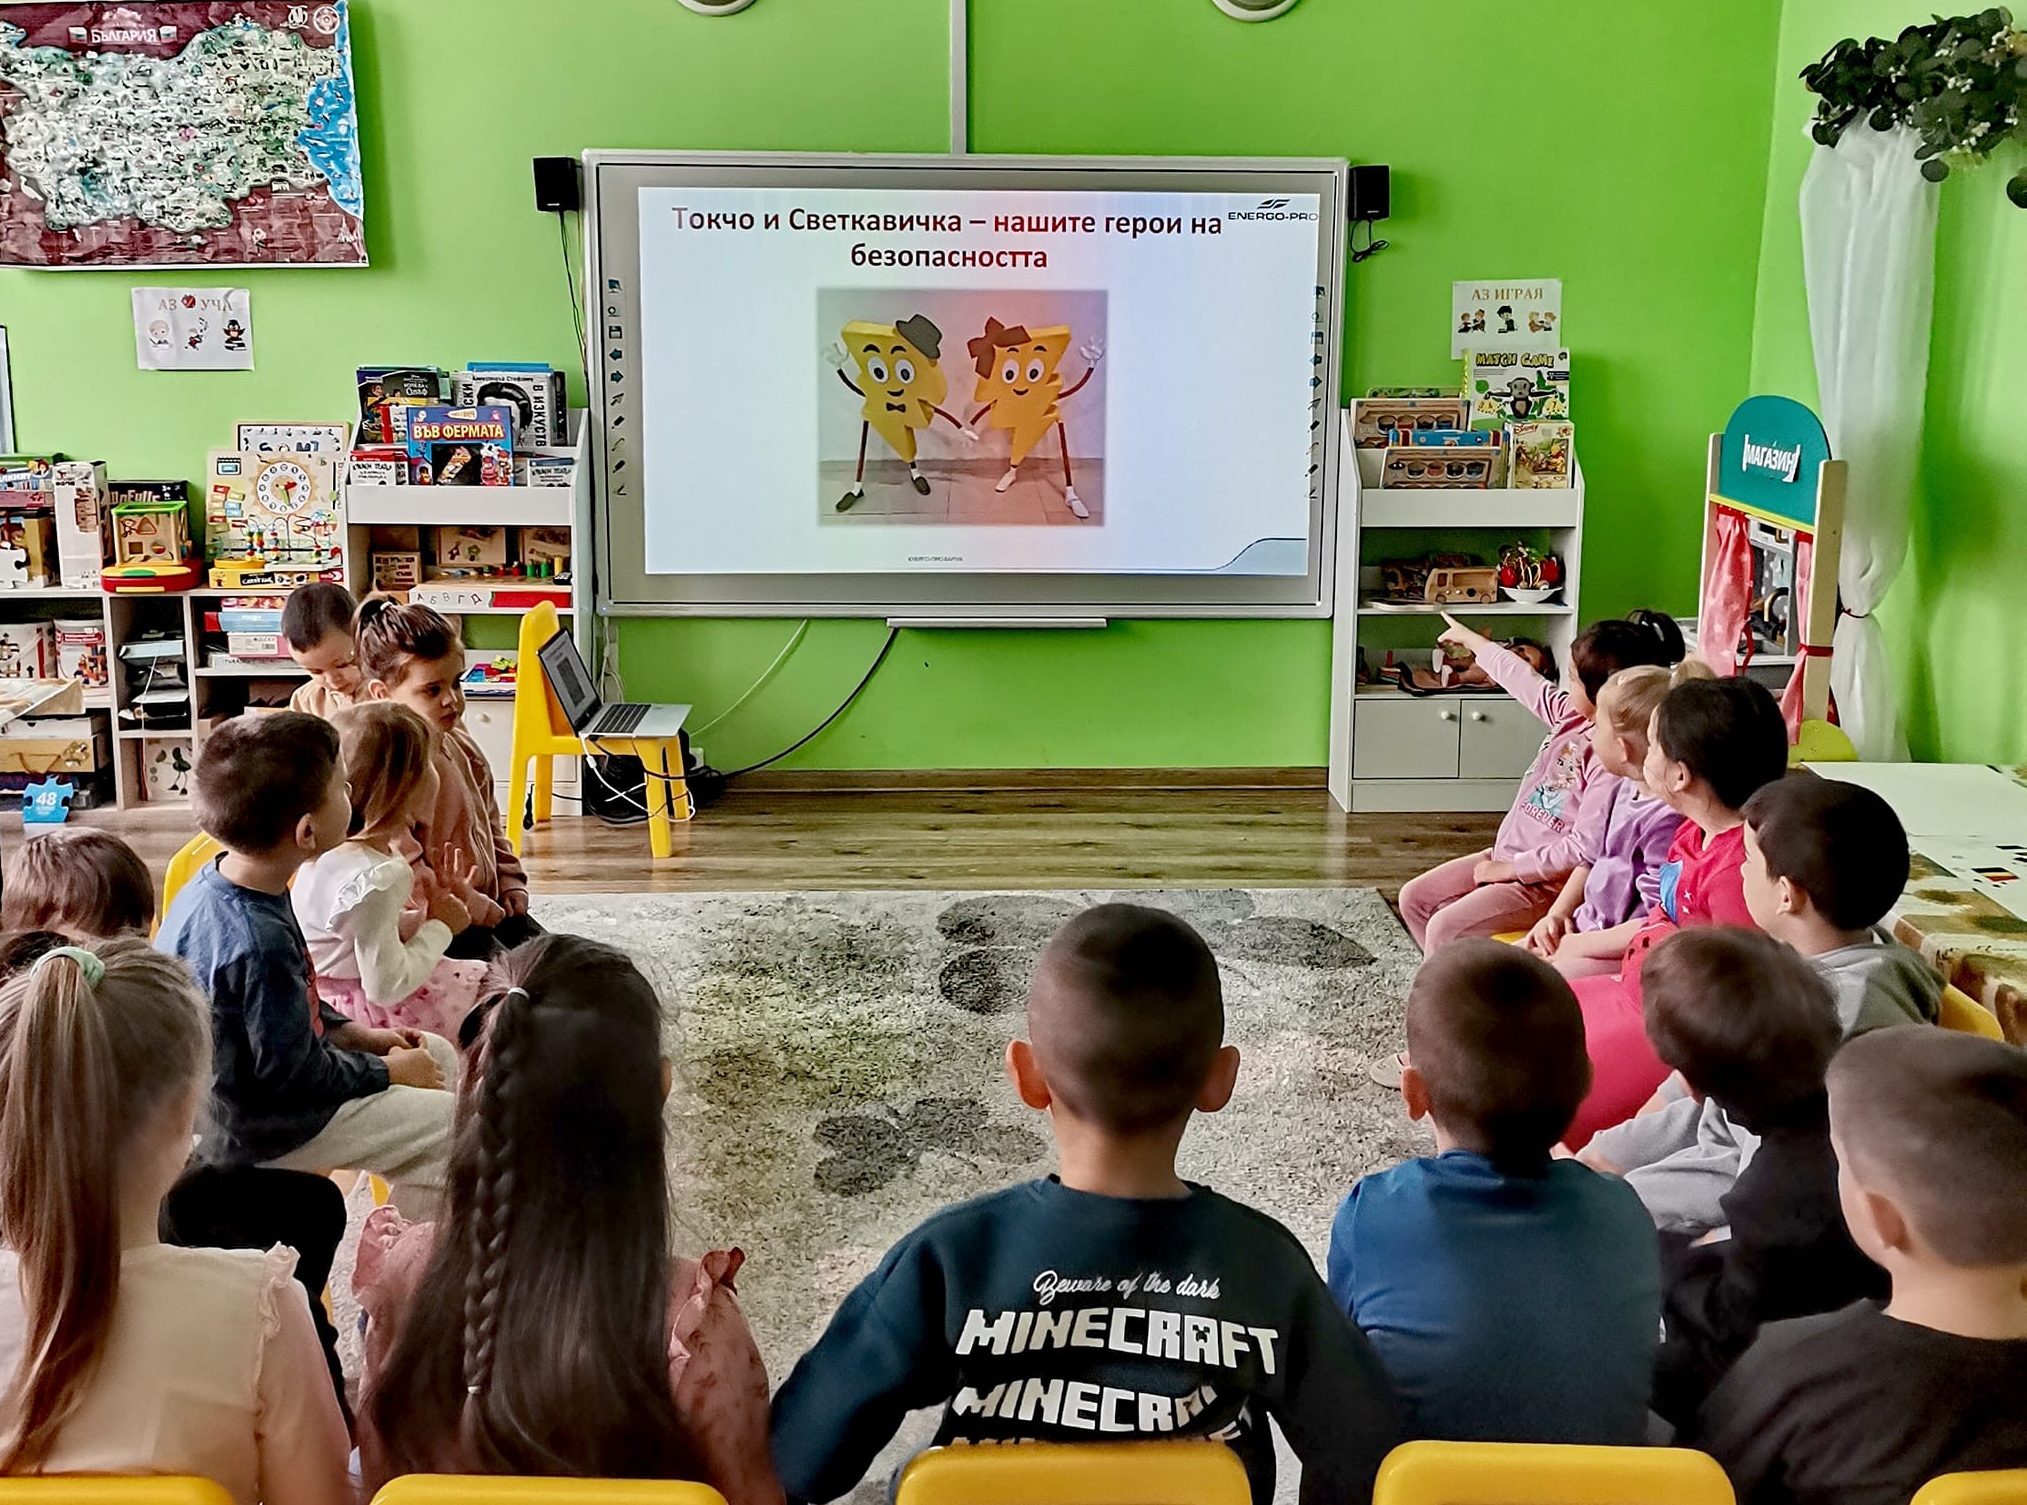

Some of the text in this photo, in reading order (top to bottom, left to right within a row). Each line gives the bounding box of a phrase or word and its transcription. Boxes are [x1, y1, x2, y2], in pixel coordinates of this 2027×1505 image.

[90, 28, 157, 43] БЪЛГАРИЯ
[672, 207, 755, 230] Токчо
[764, 213, 780, 230] и
[789, 208, 962, 232] Светкавичка
[994, 214, 1096, 233] нашите
[1105, 217, 1181, 239] герои
[1191, 217, 1221, 234] на
[851, 243, 1048, 267] безопасността
[1472, 288, 1543, 301] АЗ ИГРАЯ
[158, 298, 177, 311] АЗ
[1476, 353, 1517, 367] MATCH
[413, 424, 504, 439] ВЪВ ФЕРМАТА
[1742, 434, 1801, 483] МАГАЗИН
[36, 791, 58, 806] 48
[1519, 799, 1565, 834] FOREVER
[1033, 1270, 1221, 1307] Beware of the dark
[955, 1307, 1279, 1375] MINECRAFT
